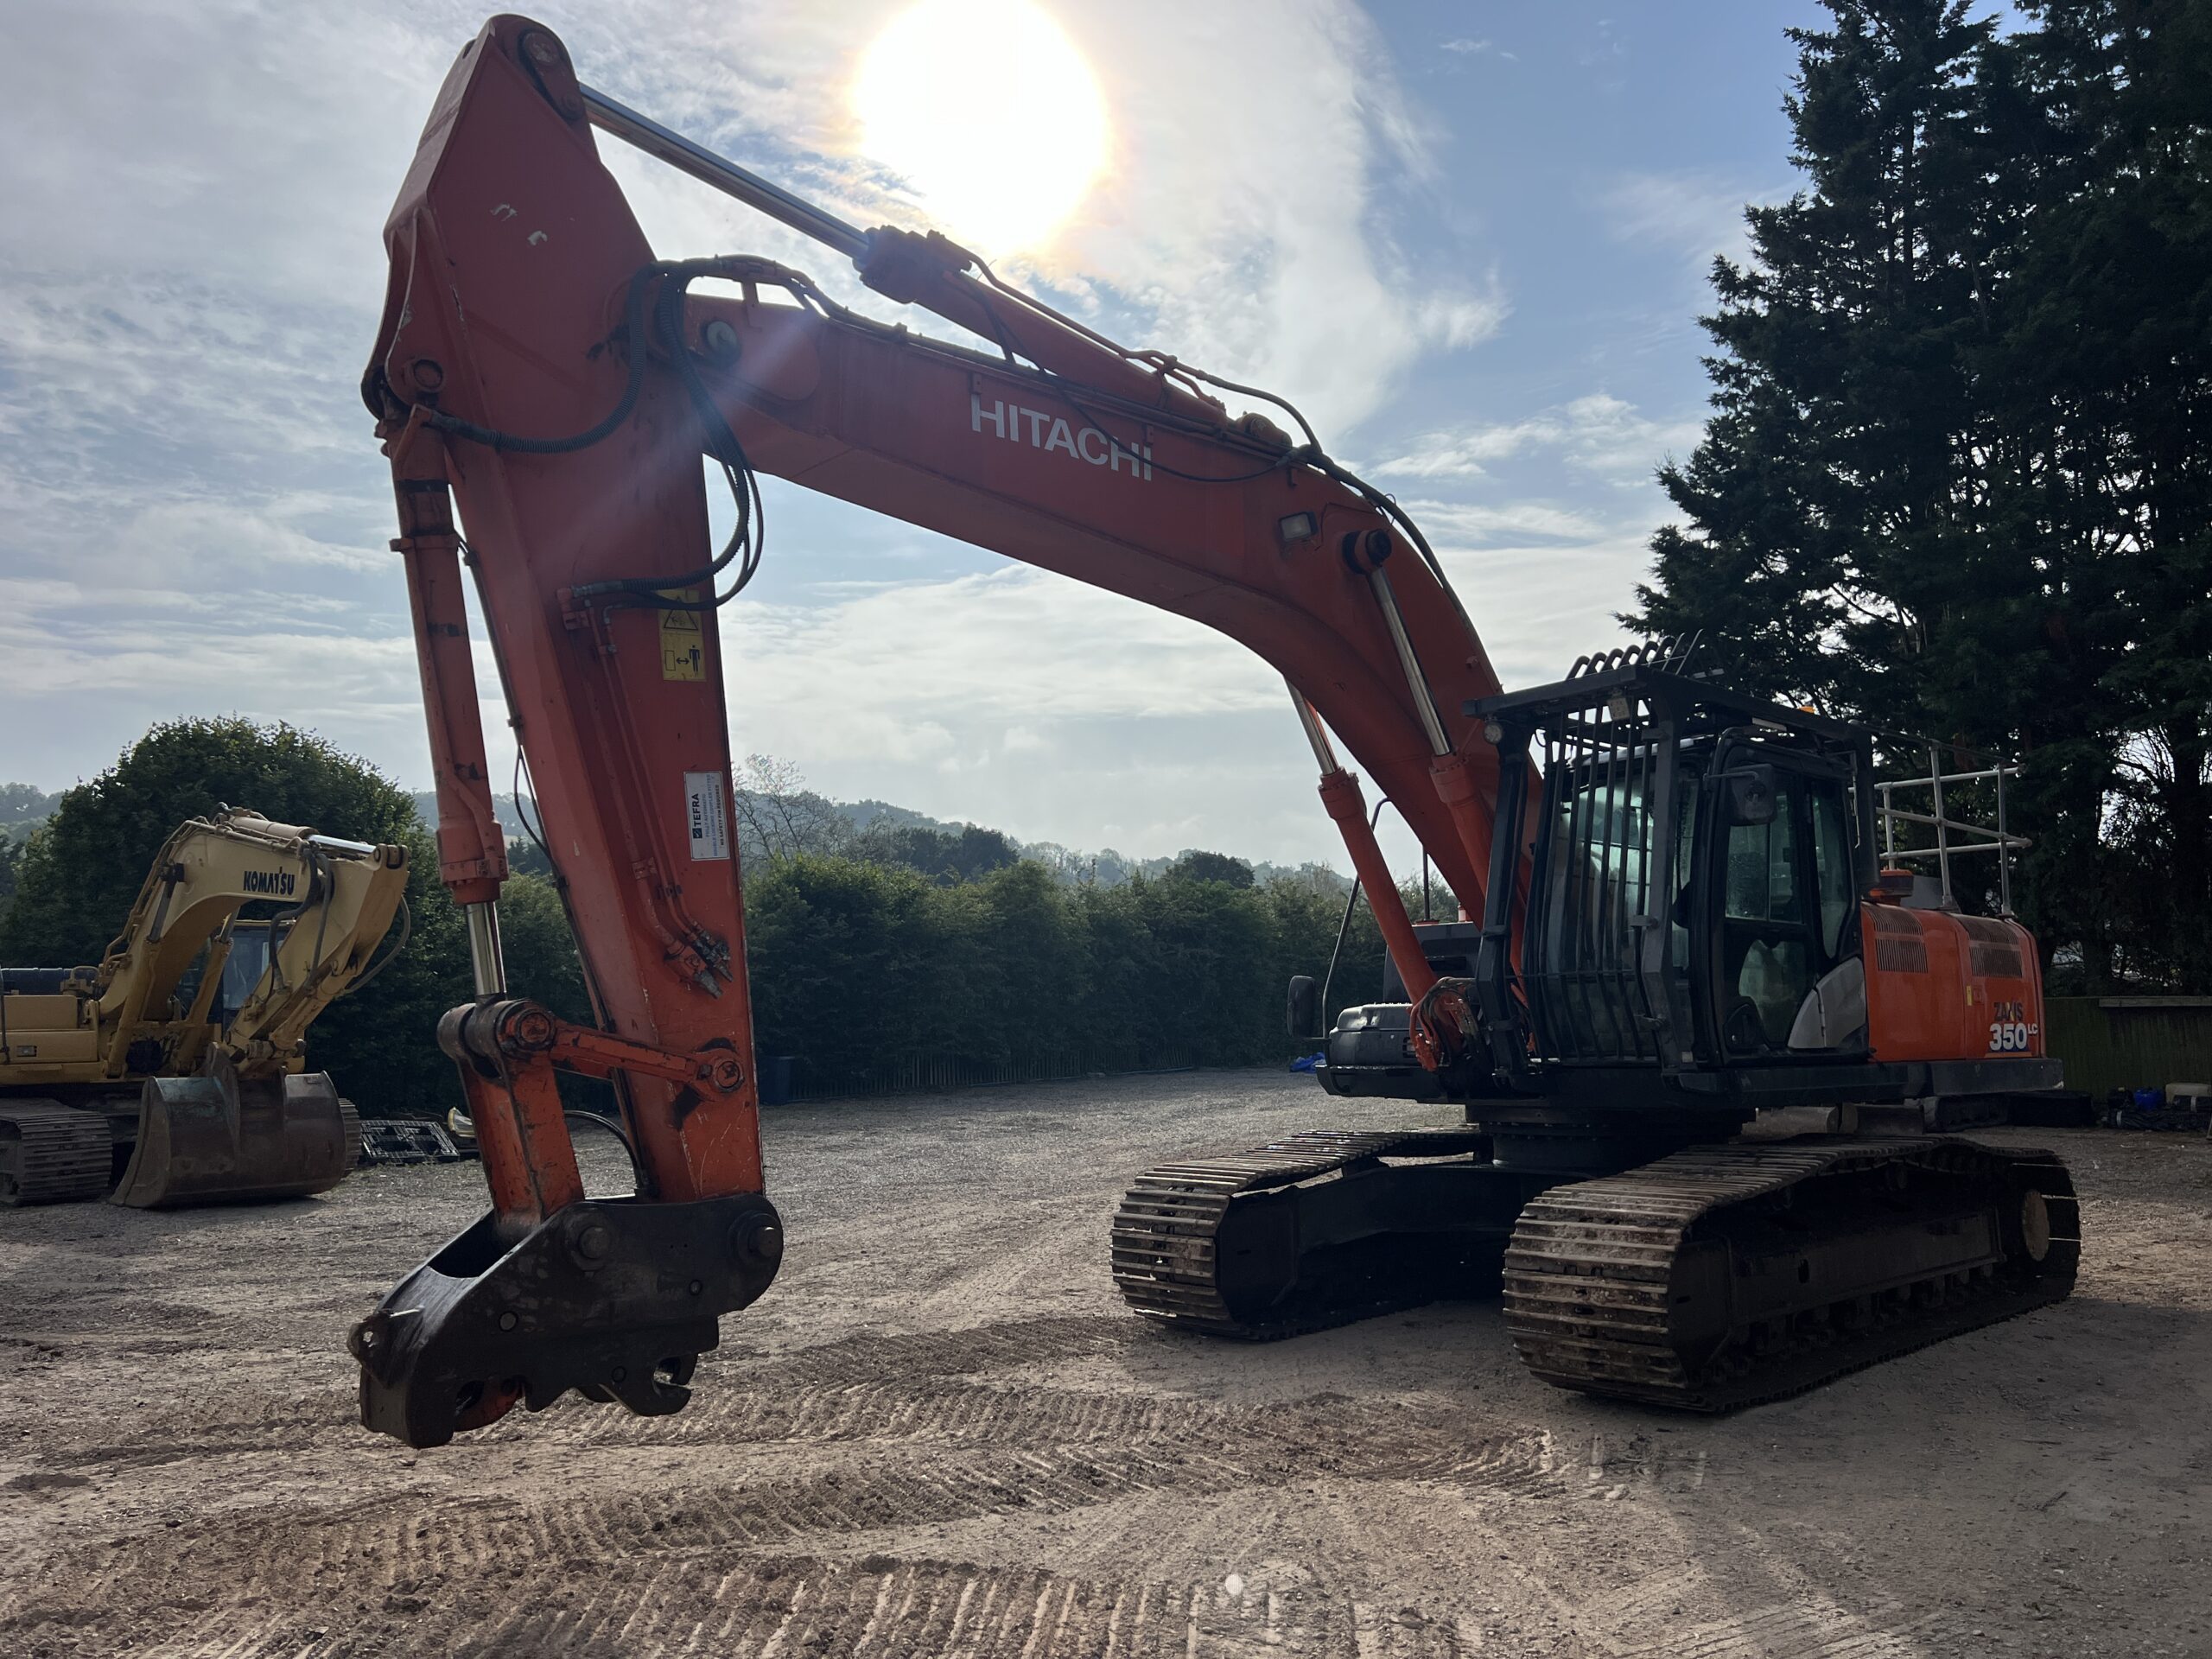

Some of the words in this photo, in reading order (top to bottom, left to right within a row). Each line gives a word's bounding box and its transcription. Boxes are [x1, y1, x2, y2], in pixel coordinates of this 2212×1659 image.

[970, 394, 1152, 481] HITACHI
[691, 793, 702, 827] TEFRA
[243, 867, 296, 895] KOMATSU
